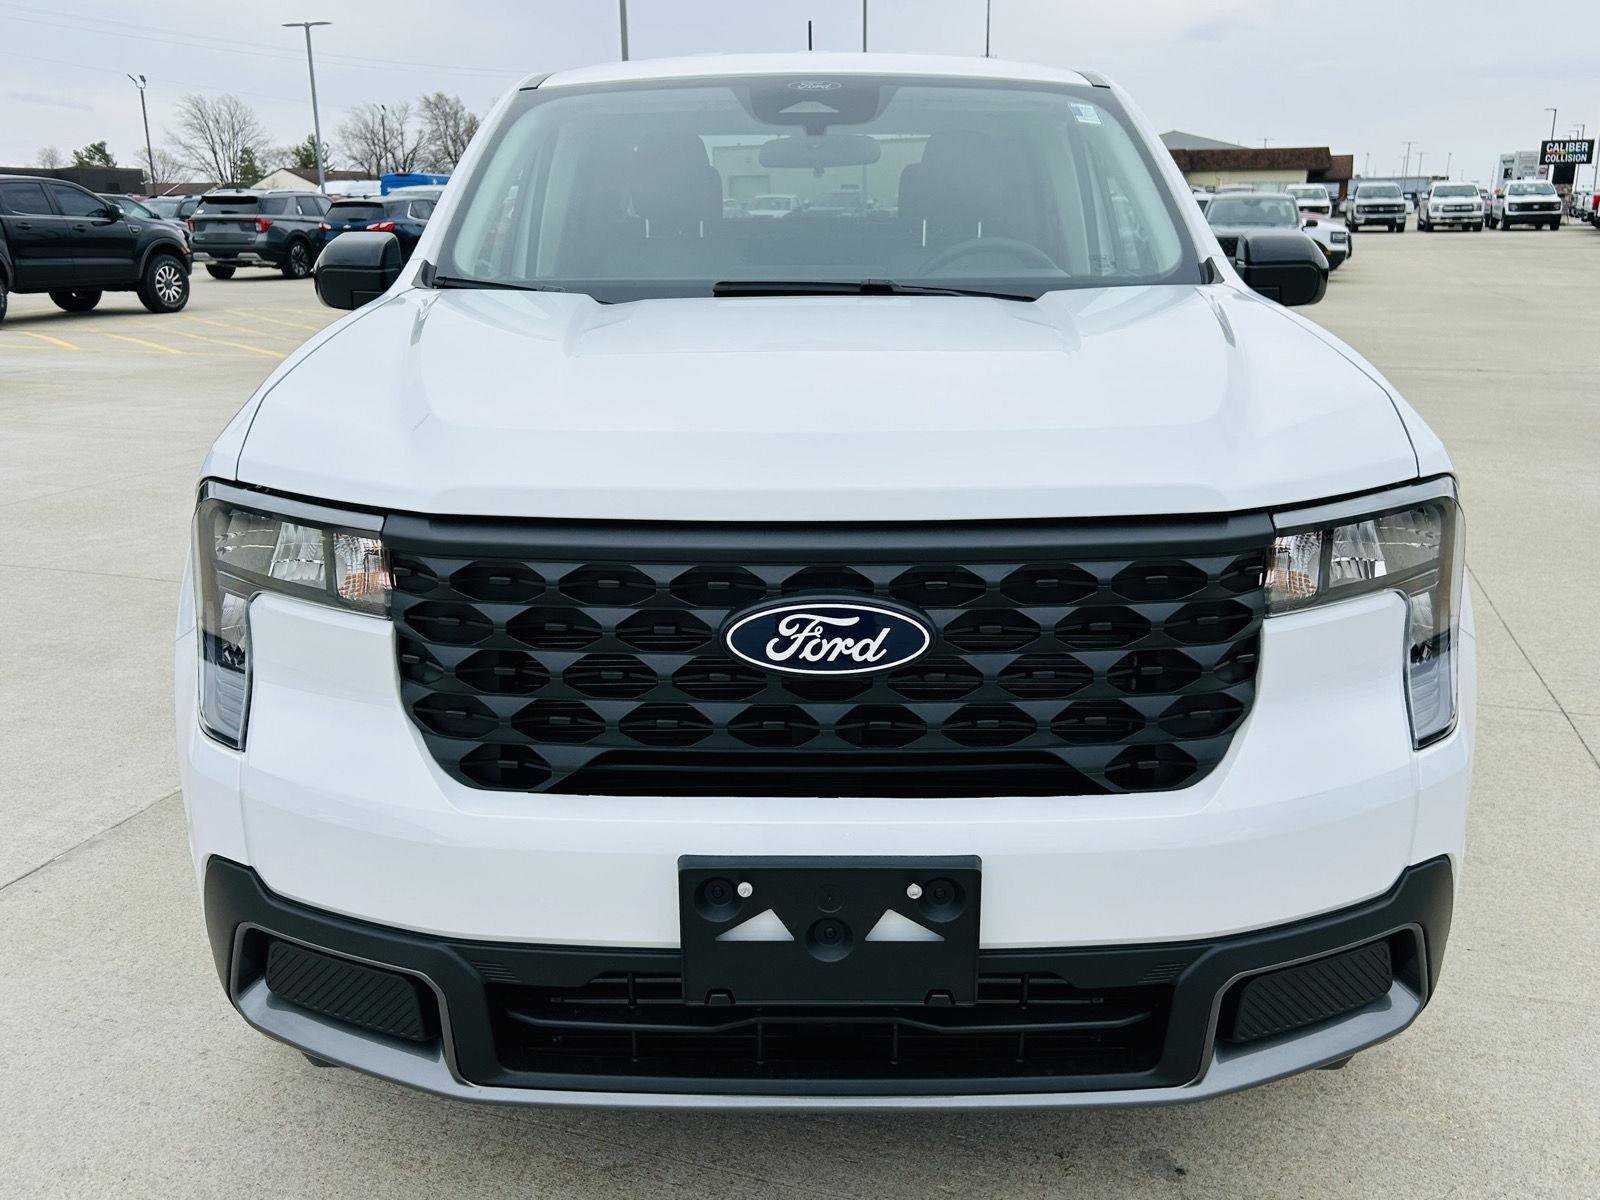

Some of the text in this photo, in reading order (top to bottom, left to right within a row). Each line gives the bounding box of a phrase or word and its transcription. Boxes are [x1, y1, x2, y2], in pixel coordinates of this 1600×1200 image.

[1546, 141, 1589, 152] CALIBER
[1545, 153, 1588, 163] COLLISION
[765, 613, 891, 662] Ford
